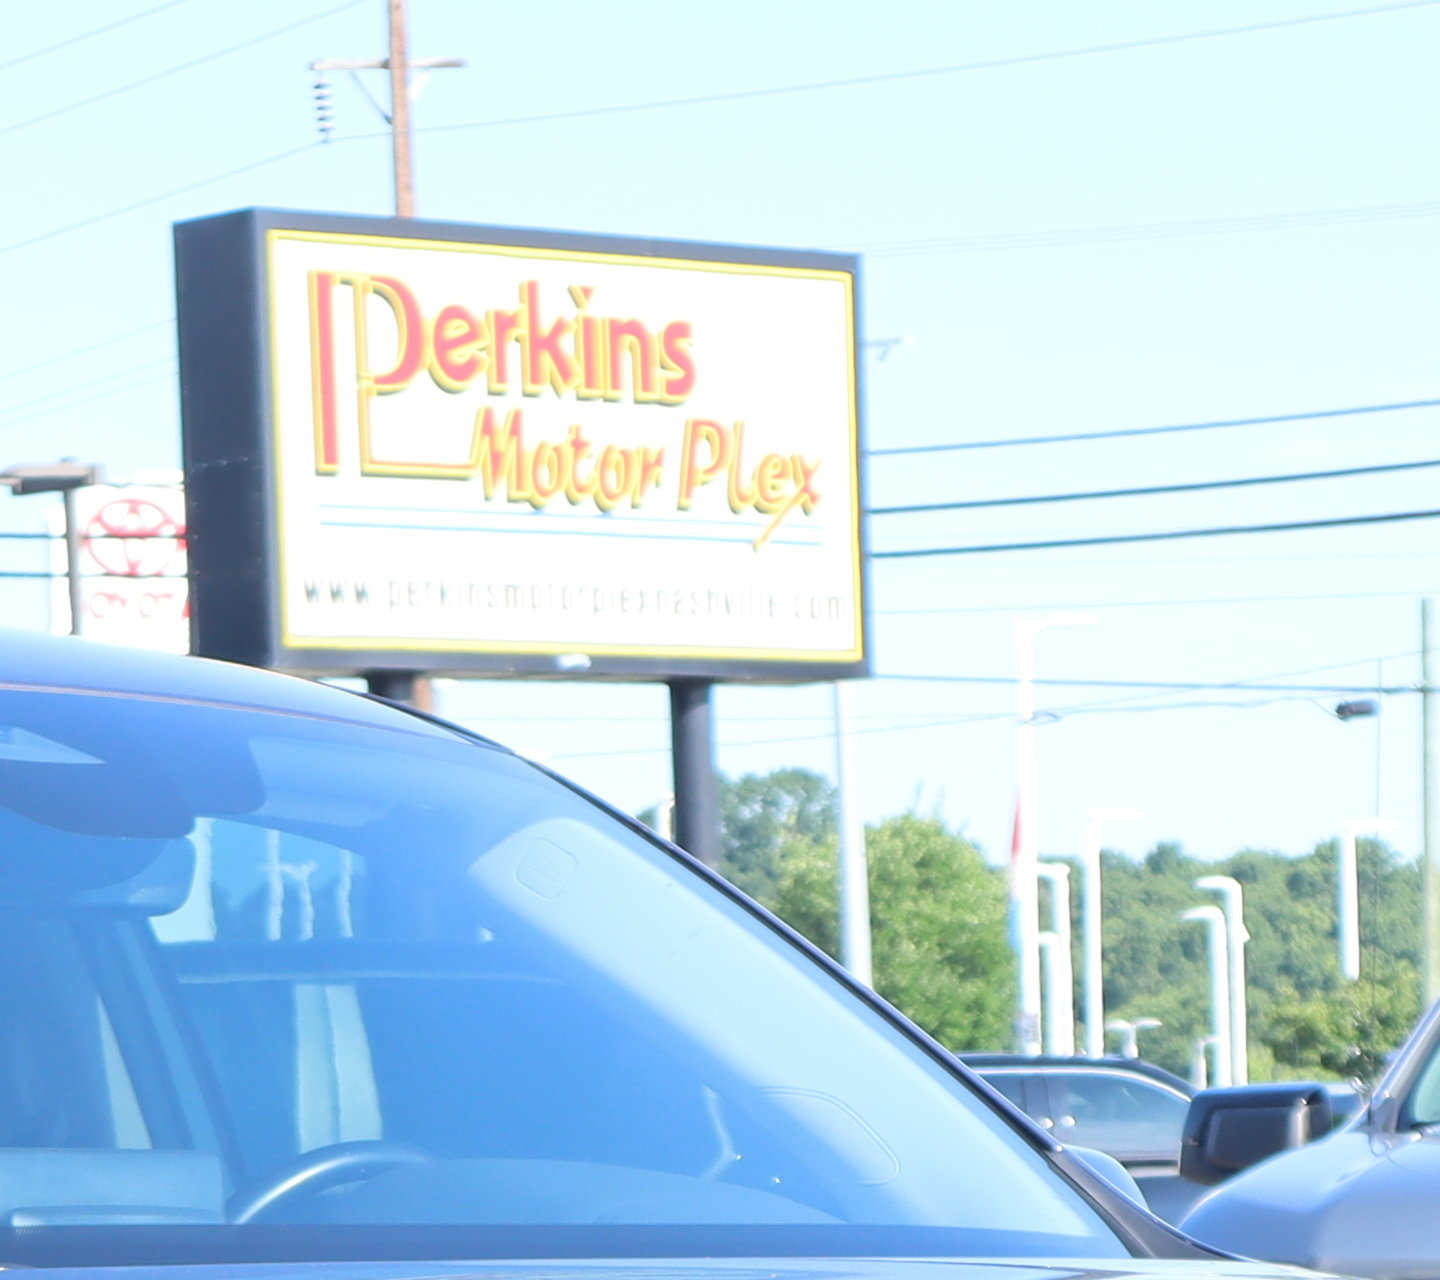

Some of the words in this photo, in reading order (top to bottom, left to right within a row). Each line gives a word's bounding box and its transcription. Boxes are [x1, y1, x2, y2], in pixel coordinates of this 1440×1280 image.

[308, 268, 698, 478] Perkins
[470, 404, 665, 512] Motor
[676, 416, 822, 552] Plex
[302, 579, 848, 623] wwwperkinsmotorplexnashvillecom
